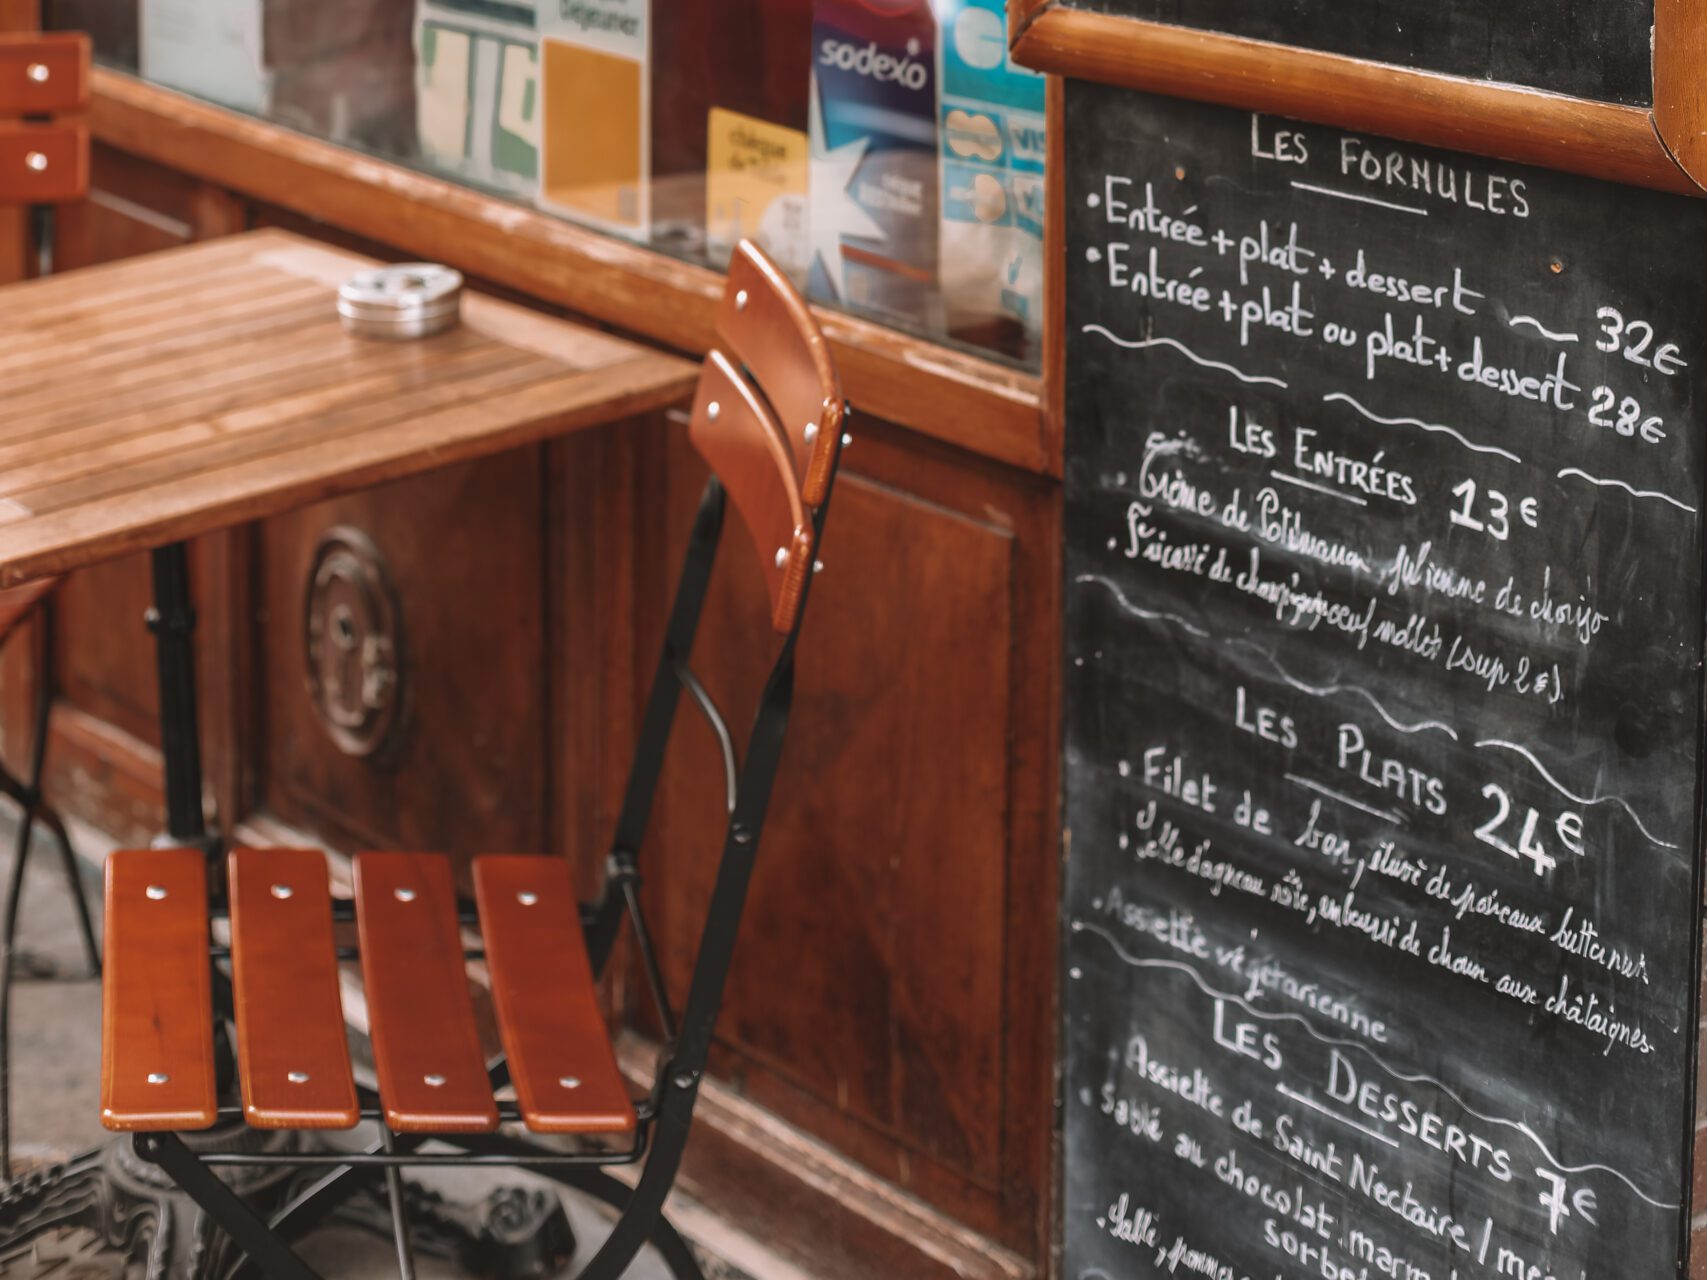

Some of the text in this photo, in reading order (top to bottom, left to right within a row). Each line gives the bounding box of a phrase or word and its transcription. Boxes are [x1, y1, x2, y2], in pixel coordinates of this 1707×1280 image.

[819, 38, 927, 90] sodexo
[1251, 113, 1309, 164] LES
[1346, 249, 1486, 315] dessert
[1596, 306, 1688, 376] 32€
[1323, 322, 1357, 346] ou
[1457, 336, 1581, 410] dessert
[1588, 385, 1667, 444] 28€
[1230, 405, 1276, 458] LES
[1295, 427, 1417, 505] ENTRÉES
[1450, 478, 1538, 540] 13€
[1208, 548, 1232, 582] de
[1222, 488, 1251, 533] de
[1495, 576, 1523, 616] de
[1143, 746, 1218, 813] Filet
[1233, 789, 1272, 836] de
[1425, 865, 1452, 900] de
[1235, 685, 1585, 877] LES PLATS 24€
[1399, 921, 1420, 956] de
[1496, 974, 1538, 1005] aux
[1125, 1035, 1224, 1118] Assiette
[1232, 1100, 1263, 1138] de
[1273, 1114, 1343, 1182] Saint
[1350, 1153, 1471, 1254] Nectaire
[1175, 1132, 1206, 1168] au
[1213, 999, 1598, 1236] LES DESSERTS 7€
